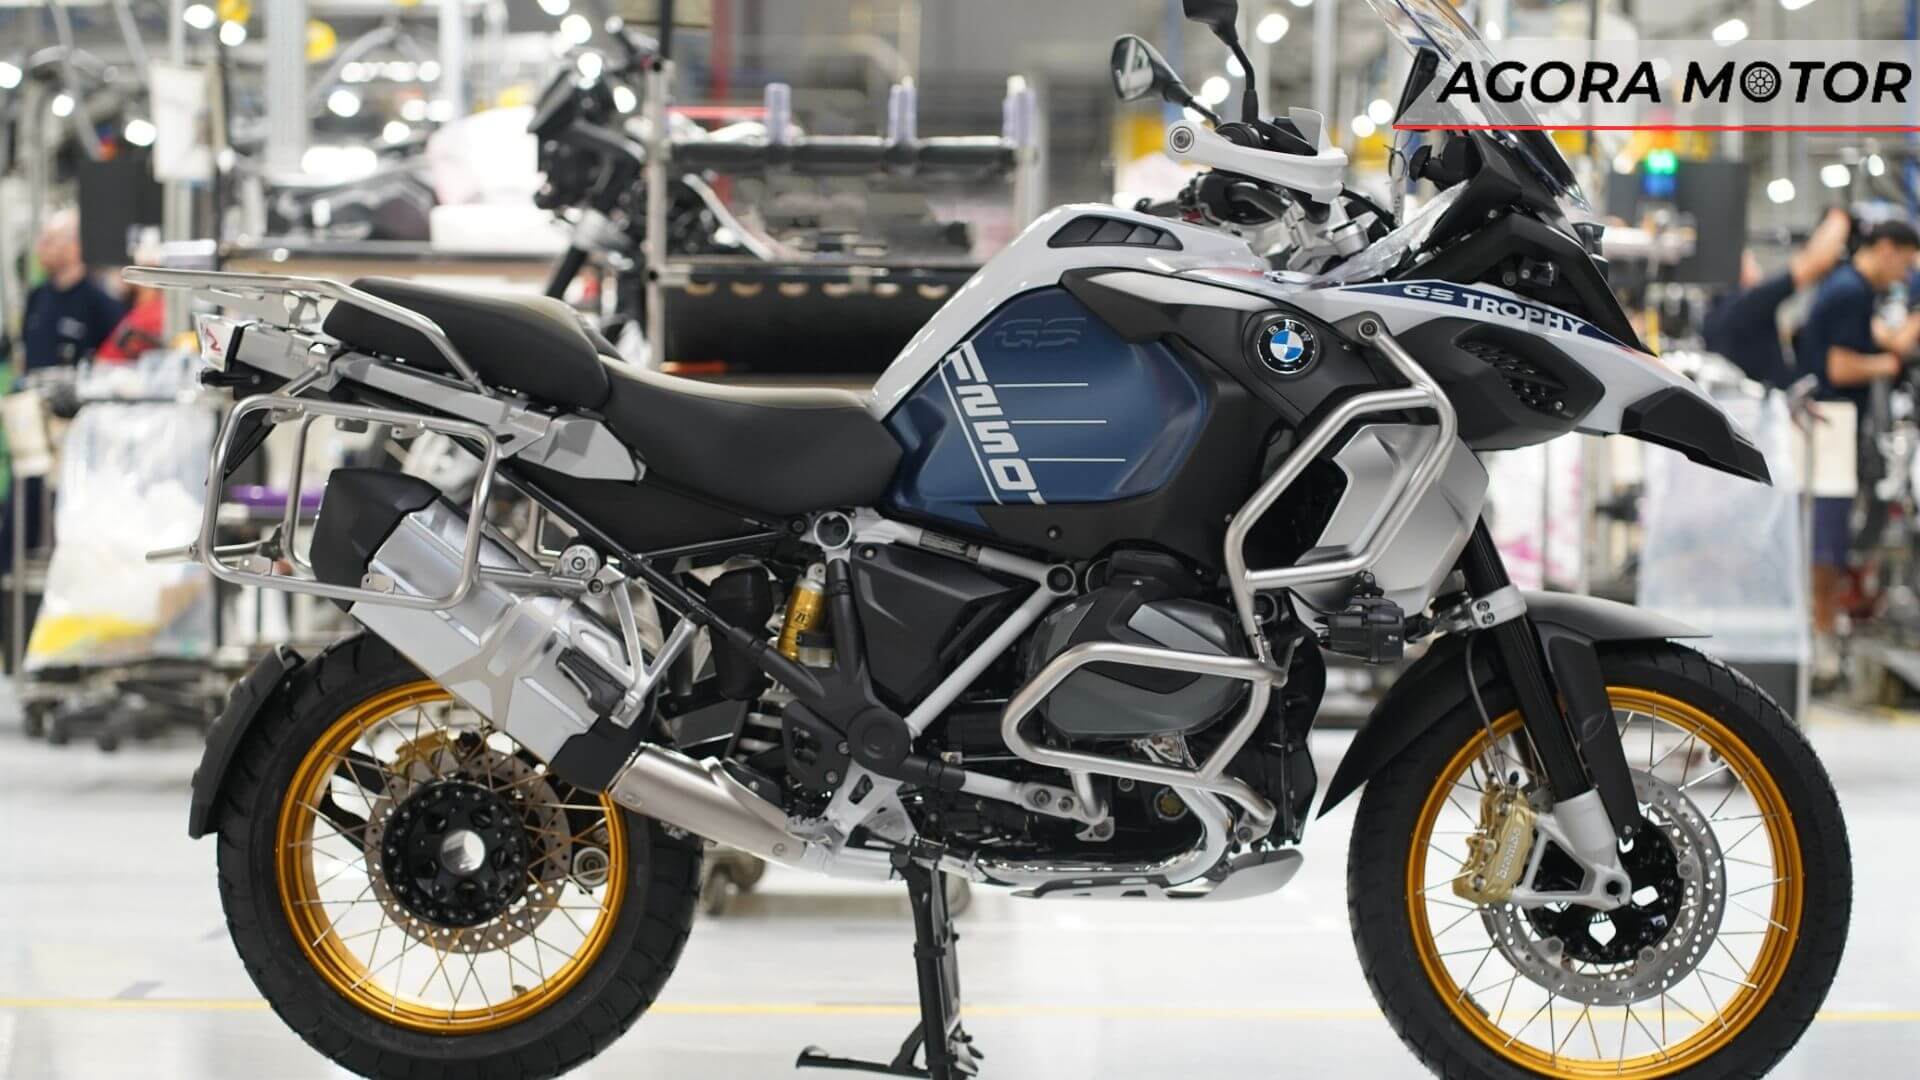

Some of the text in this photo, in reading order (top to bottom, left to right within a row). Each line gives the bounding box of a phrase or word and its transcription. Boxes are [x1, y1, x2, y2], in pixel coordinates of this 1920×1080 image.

[1402, 283, 1585, 336] GS TROPHY
[994, 317, 1087, 348] GS
